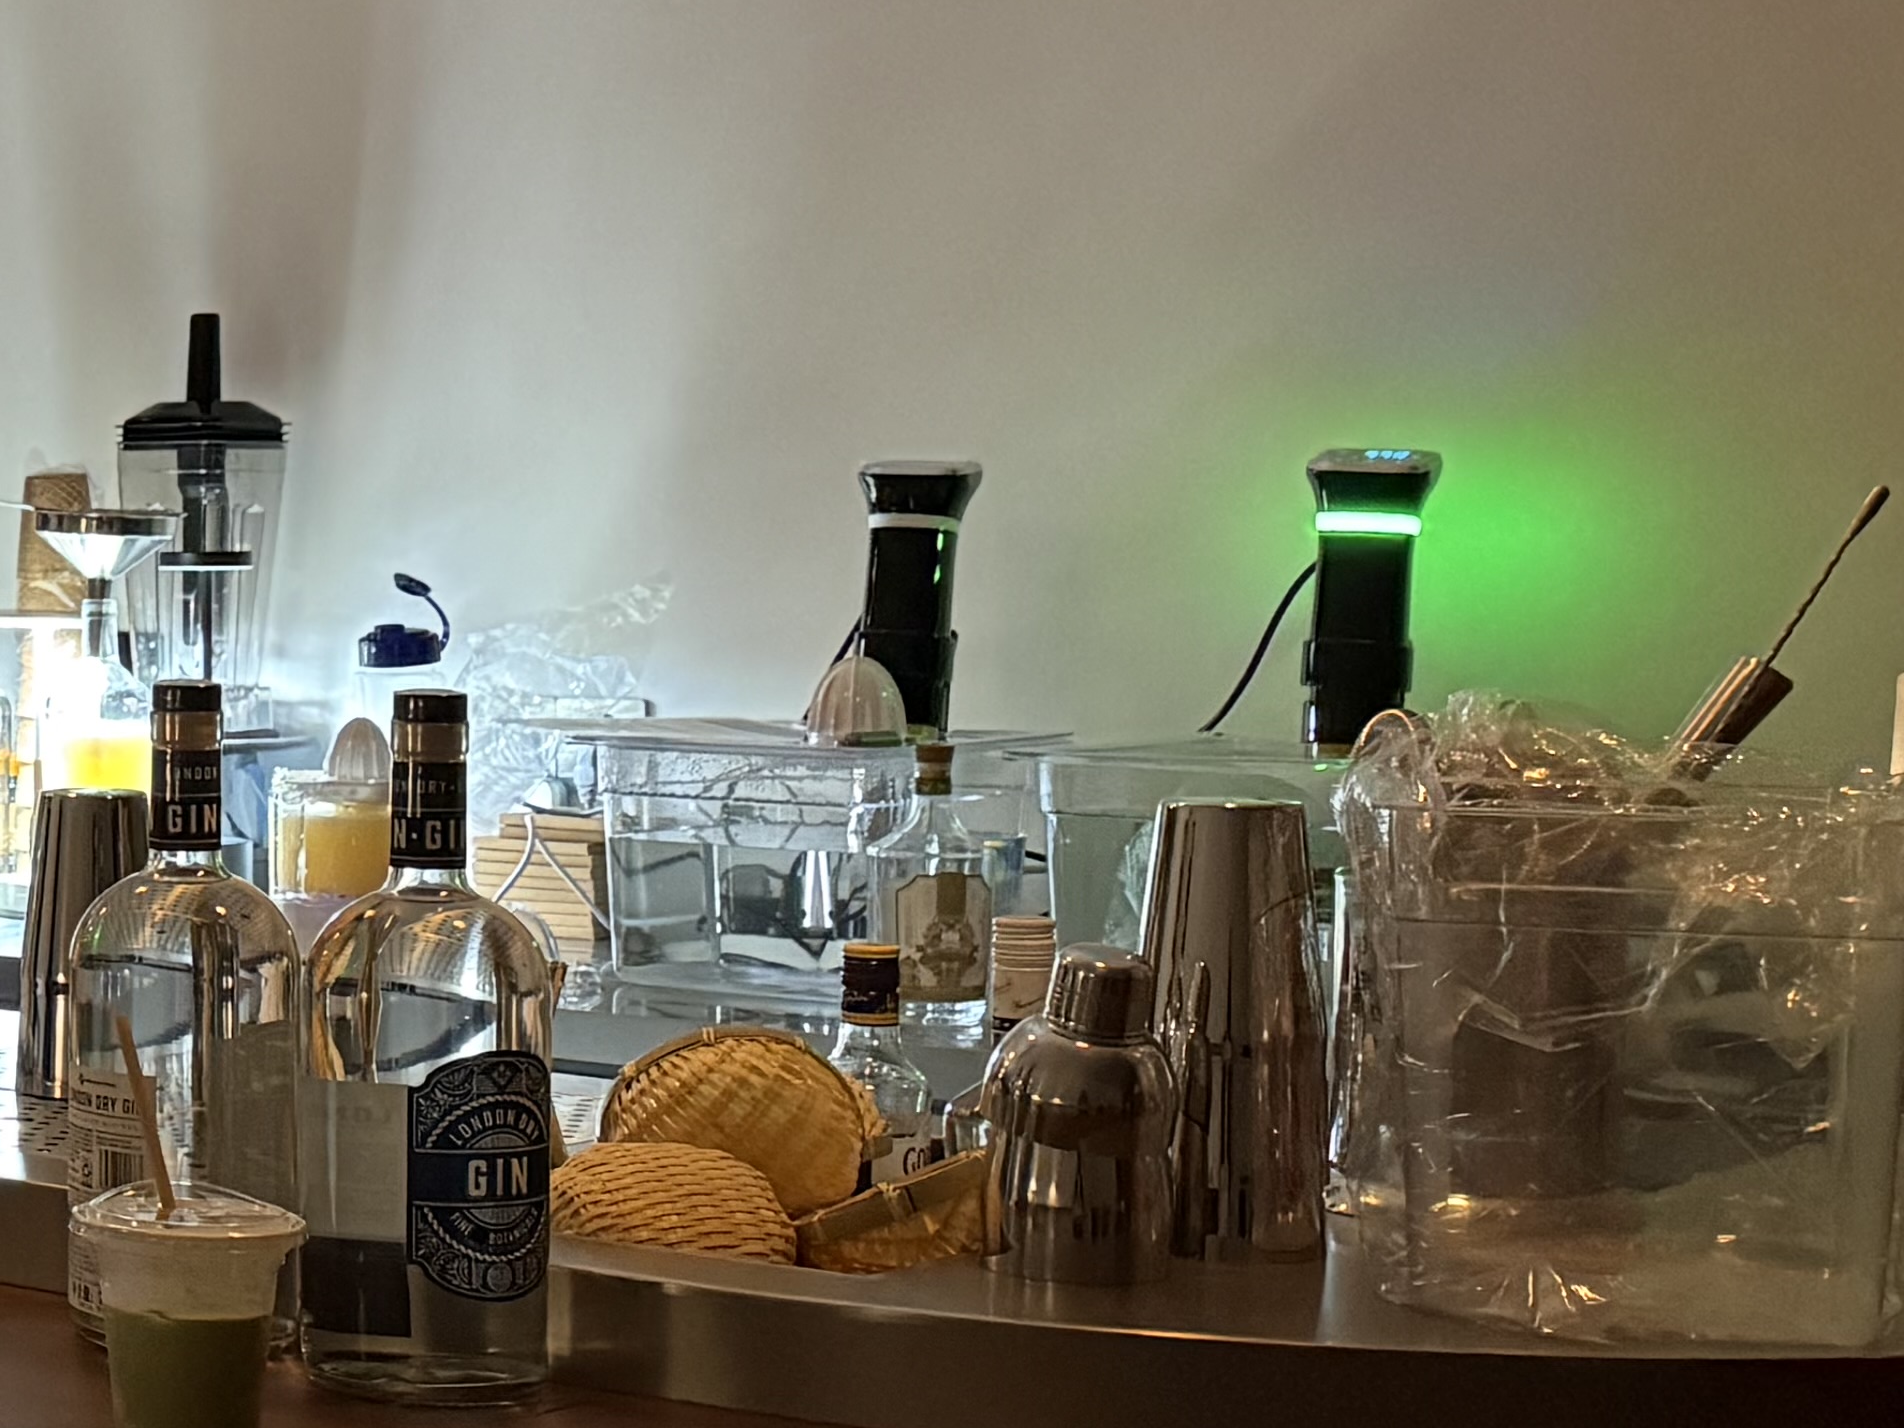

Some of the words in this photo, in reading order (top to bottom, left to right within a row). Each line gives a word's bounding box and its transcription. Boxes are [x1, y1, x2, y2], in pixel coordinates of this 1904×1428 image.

[168, 804, 217, 834] GIN
[95, 1094, 118, 1113] DRY
[449, 1108, 516, 1146] LONDON
[518, 1113, 540, 1142] DRY
[467, 1155, 529, 1198] GIN
